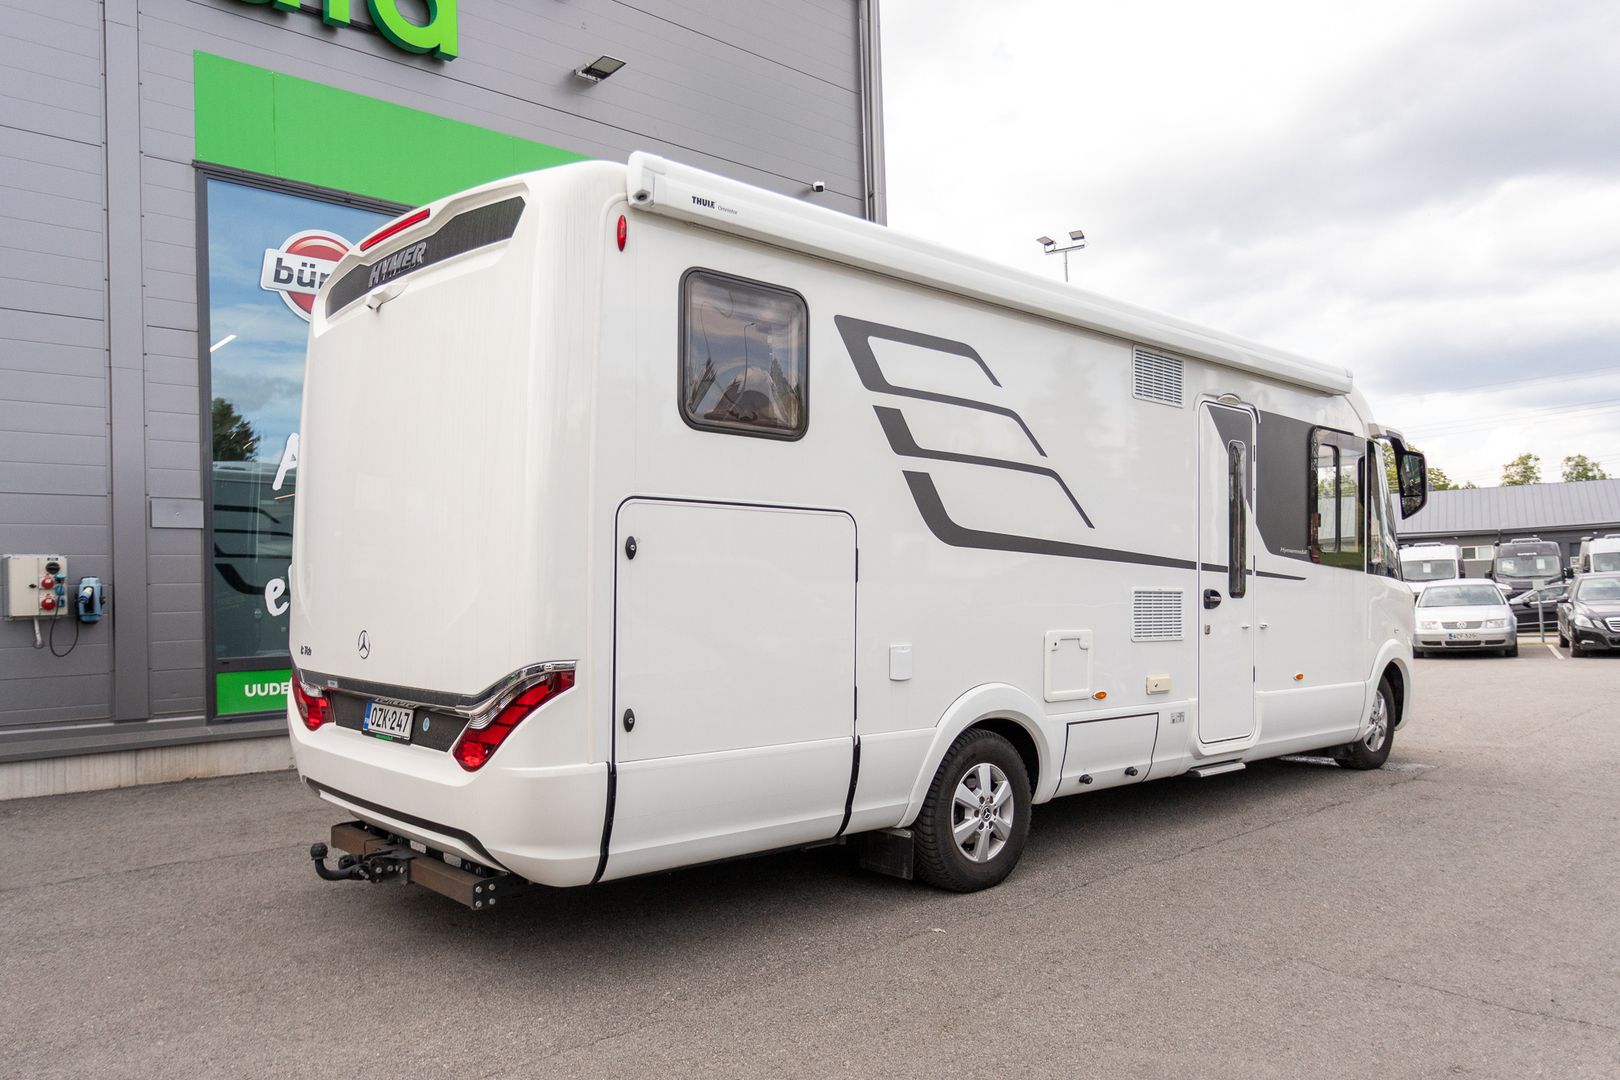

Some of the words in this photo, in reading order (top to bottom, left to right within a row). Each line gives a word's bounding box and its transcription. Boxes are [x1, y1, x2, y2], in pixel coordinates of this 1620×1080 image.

[691, 195, 716, 209] THULE
[368, 241, 427, 288] HYMER
[370, 706, 411, 733] OZK-247
